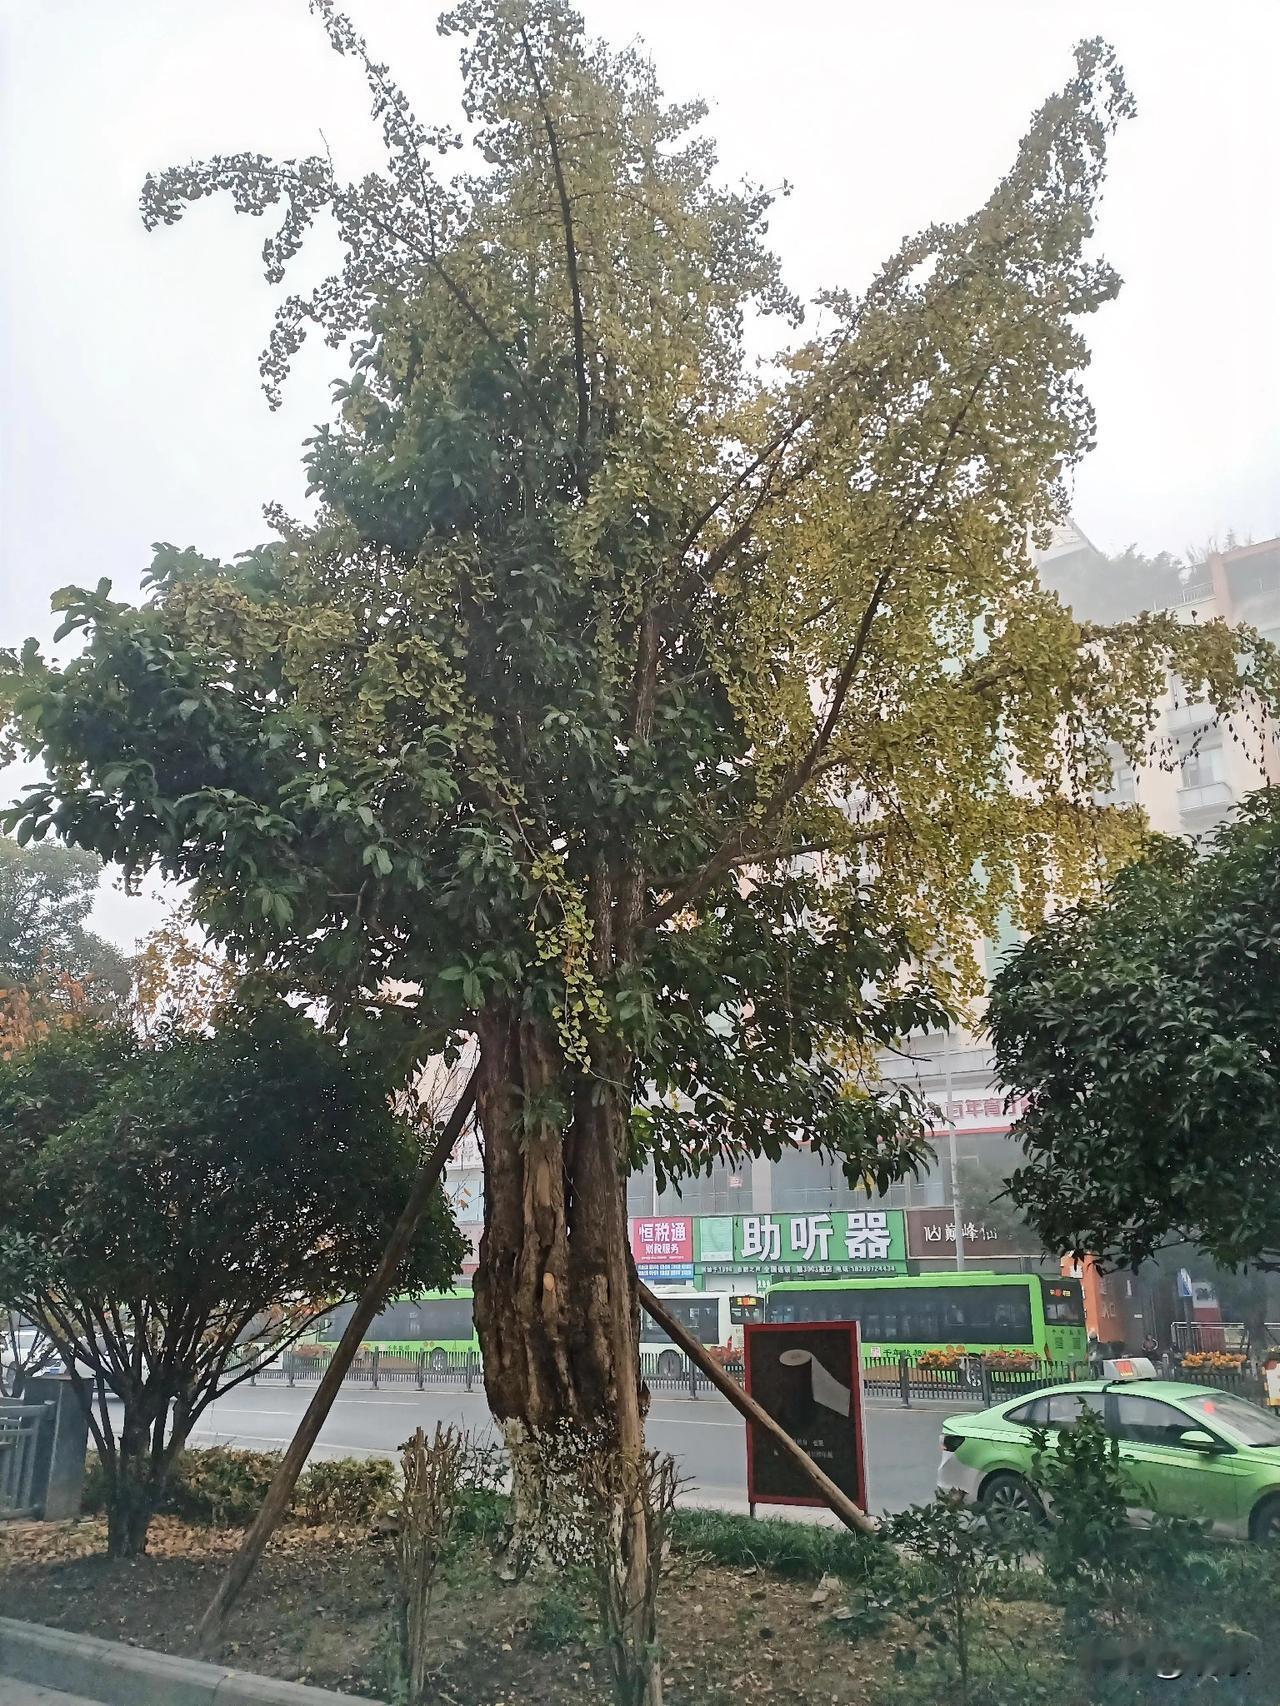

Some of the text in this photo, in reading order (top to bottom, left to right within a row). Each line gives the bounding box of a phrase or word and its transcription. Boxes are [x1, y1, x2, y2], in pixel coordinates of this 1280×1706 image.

[639, 1222, 686, 1242] 恒税通
[741, 1212, 891, 1261] 助听器
